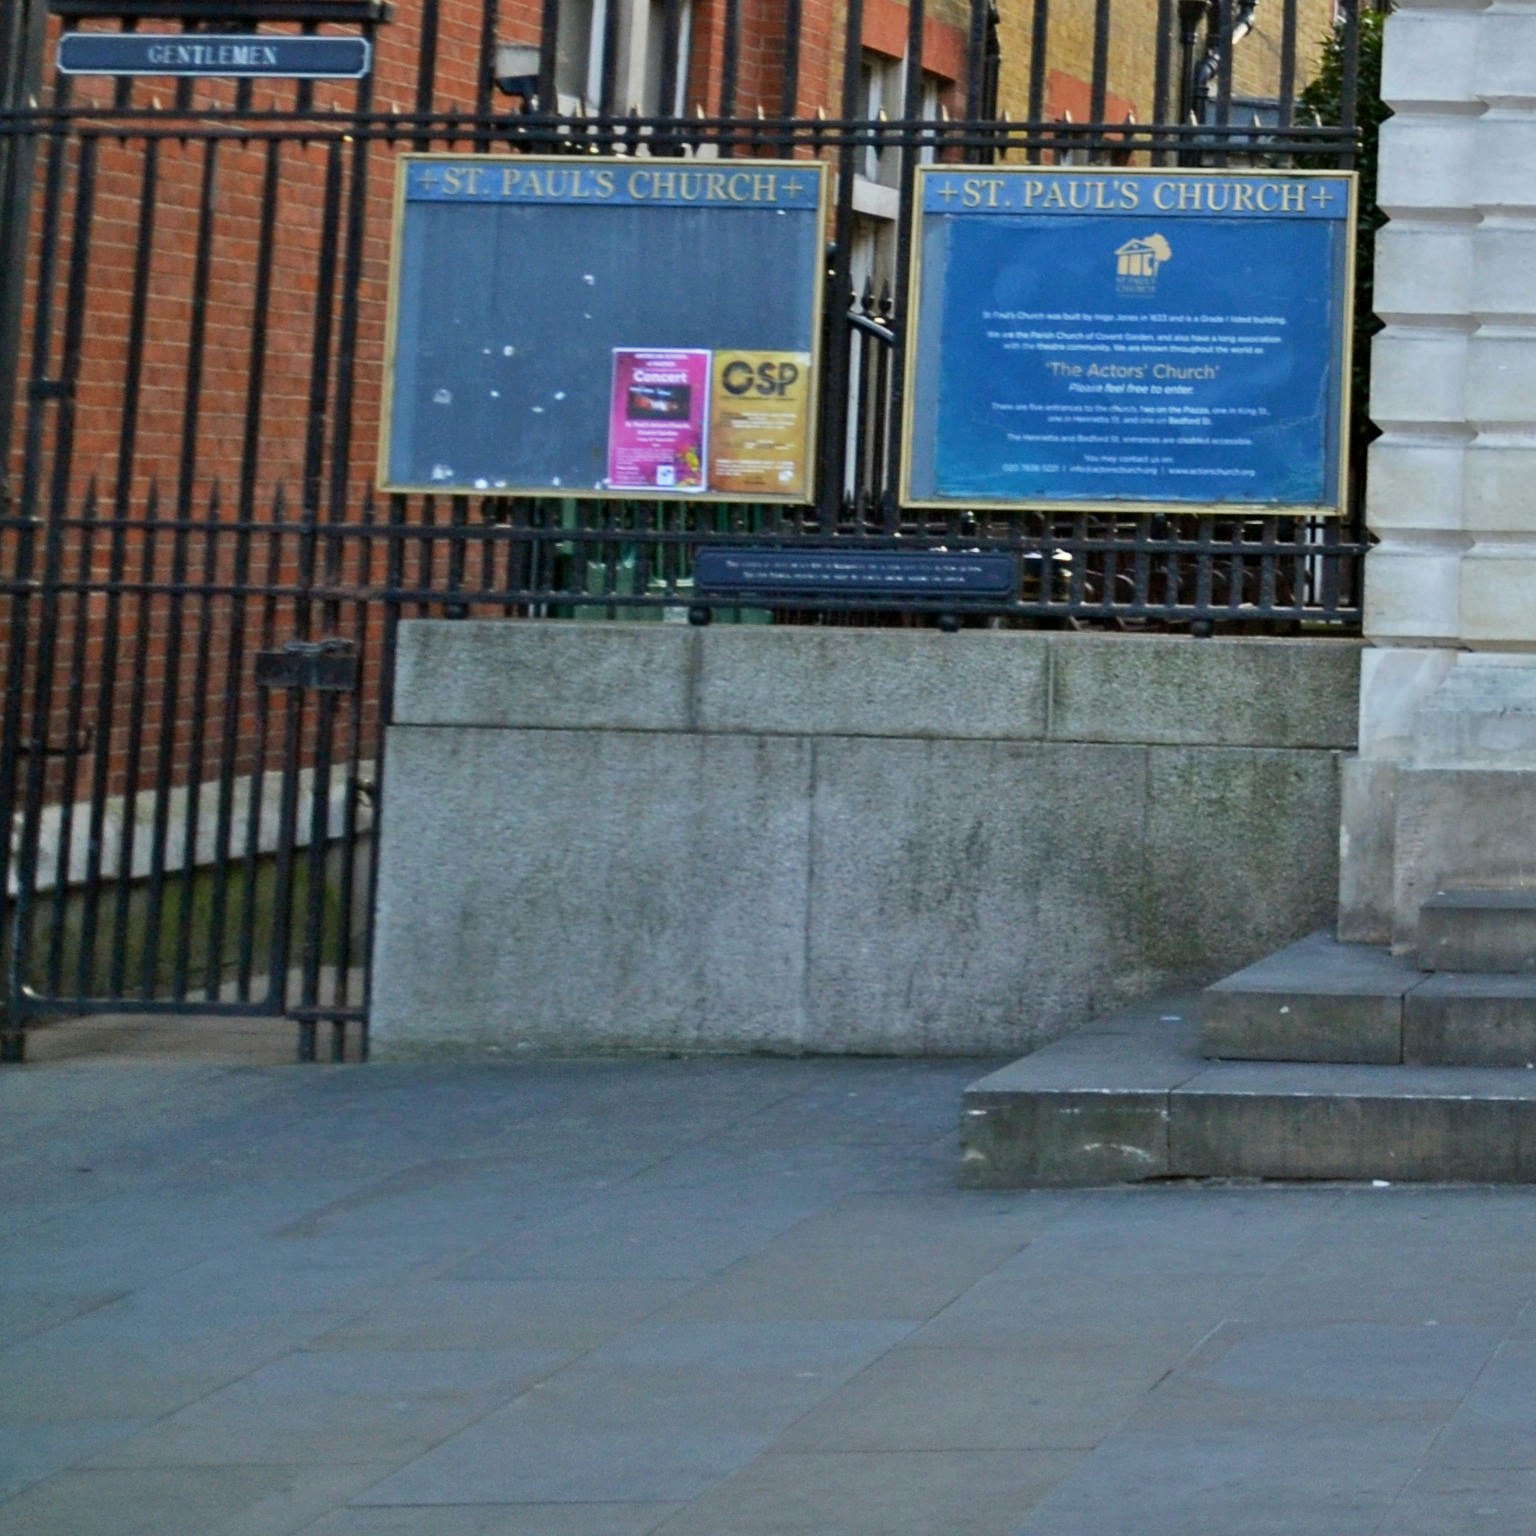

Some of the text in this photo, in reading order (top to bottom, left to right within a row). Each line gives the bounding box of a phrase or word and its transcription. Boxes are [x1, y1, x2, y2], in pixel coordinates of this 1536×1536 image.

[147, 45, 279, 66] GENTLEMEN
[442, 166, 778, 202] ST. PAUL'S CHURCH
[962, 178, 1308, 213] ST. PAUL'S CHURCH
[633, 370, 689, 384] Concert
